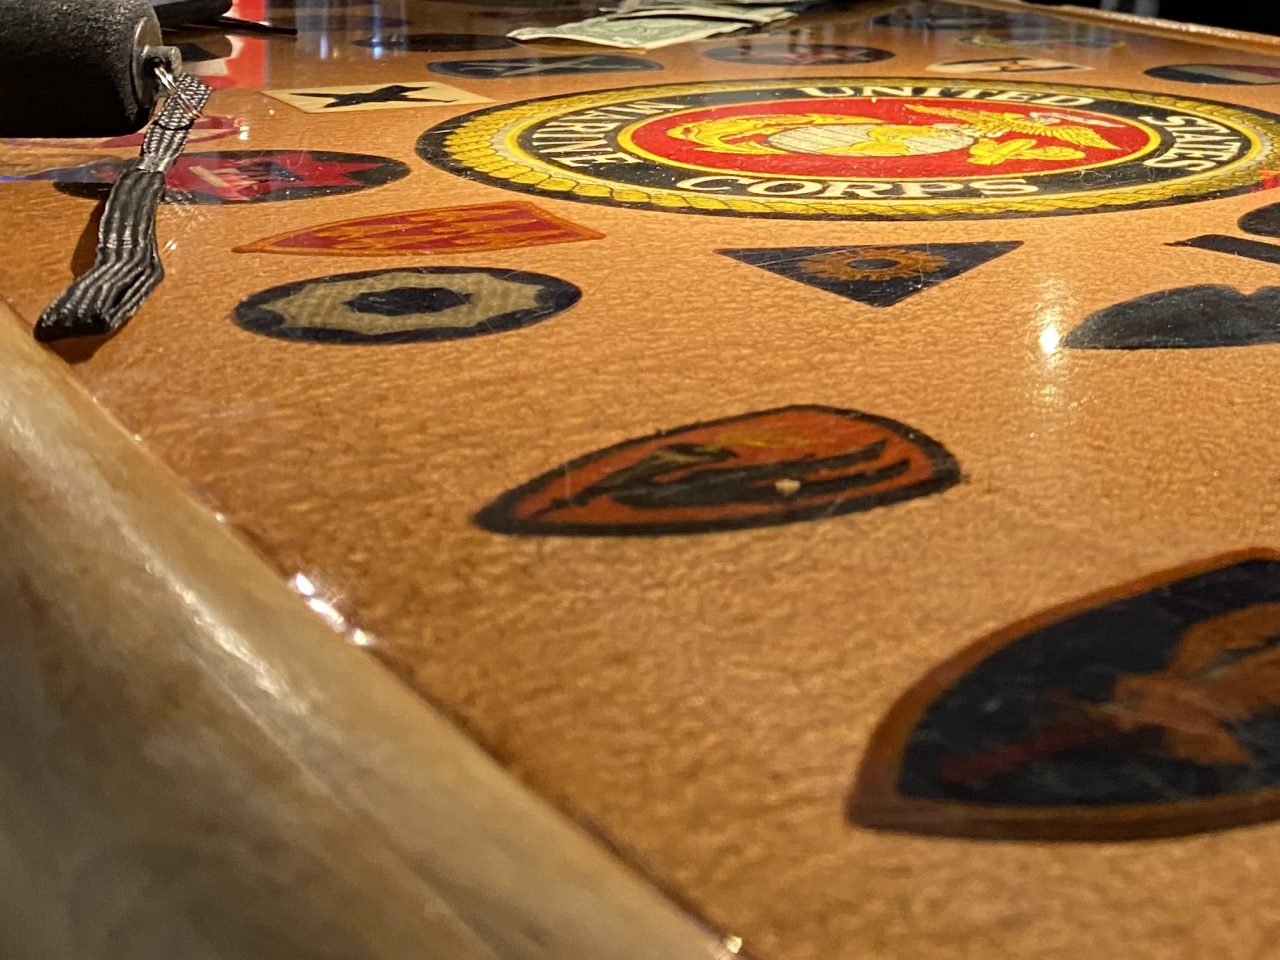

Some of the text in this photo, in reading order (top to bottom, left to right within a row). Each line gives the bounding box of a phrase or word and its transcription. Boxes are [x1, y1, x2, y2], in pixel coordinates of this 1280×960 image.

[531, 100, 1041, 200] MARINE CORPS
[795, 85, 1243, 172] UNITED STATES
